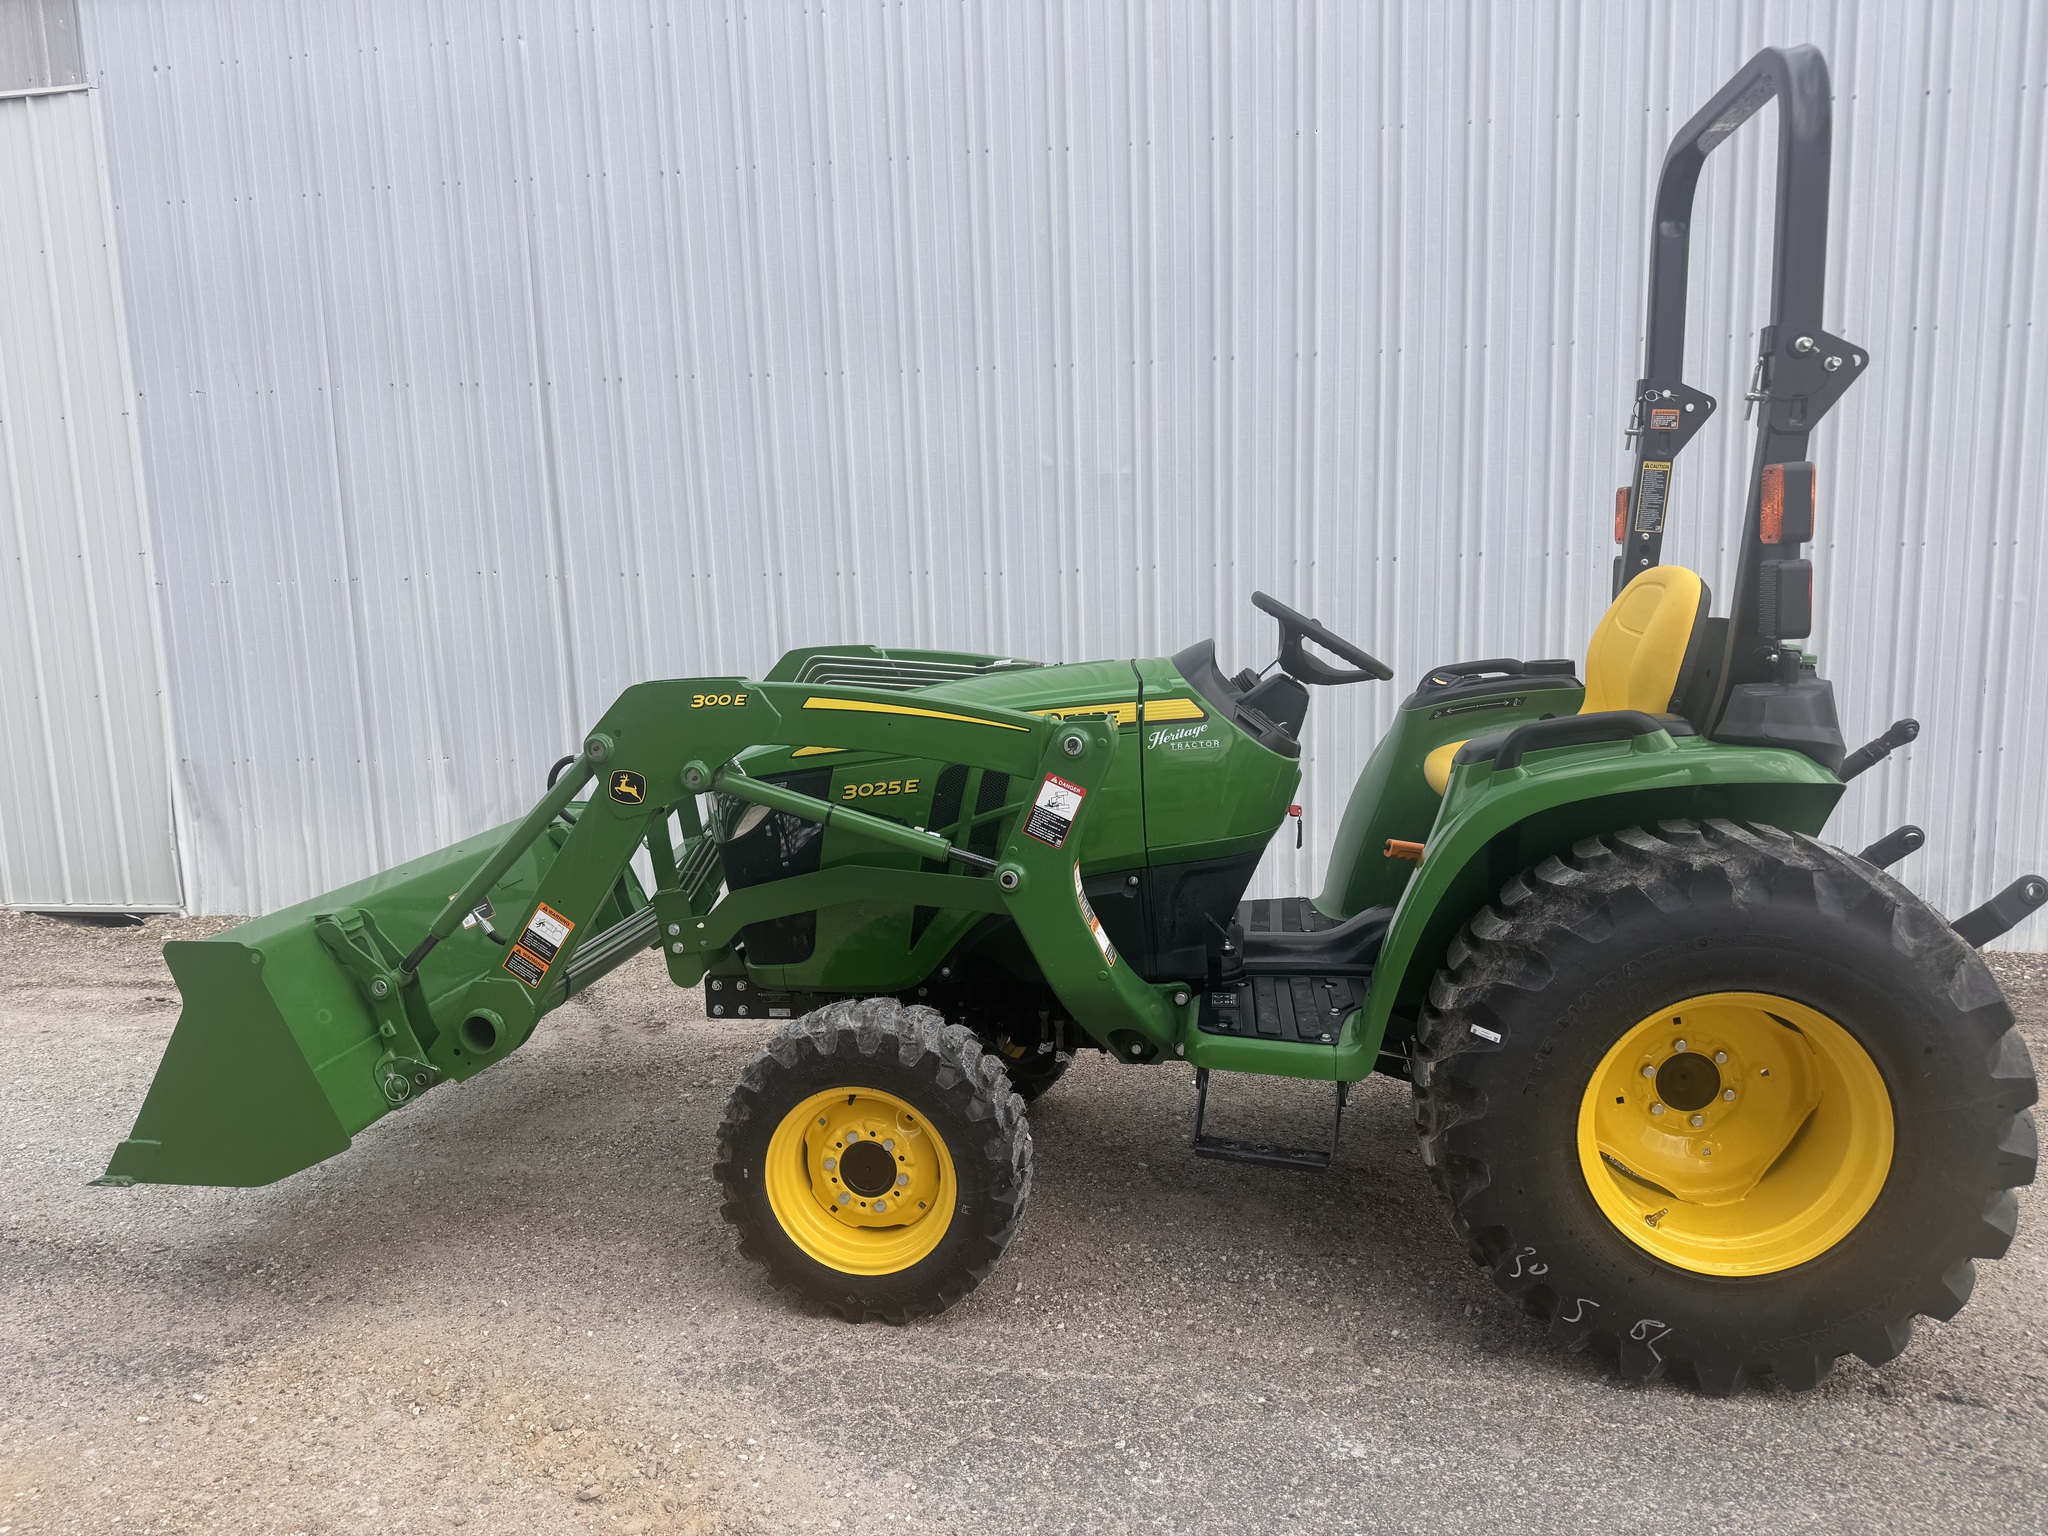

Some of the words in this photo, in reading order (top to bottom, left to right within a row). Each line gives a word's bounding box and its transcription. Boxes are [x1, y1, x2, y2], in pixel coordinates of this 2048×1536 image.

[1147, 724, 1208, 750] Heritage
[1170, 740, 1220, 750] TRACTOR
[1058, 780, 1081, 793] DANGER
[548, 909, 570, 927] WARNING
[522, 952, 545, 969] WARNING
[1556, 934, 1793, 1029] MARATHONER
